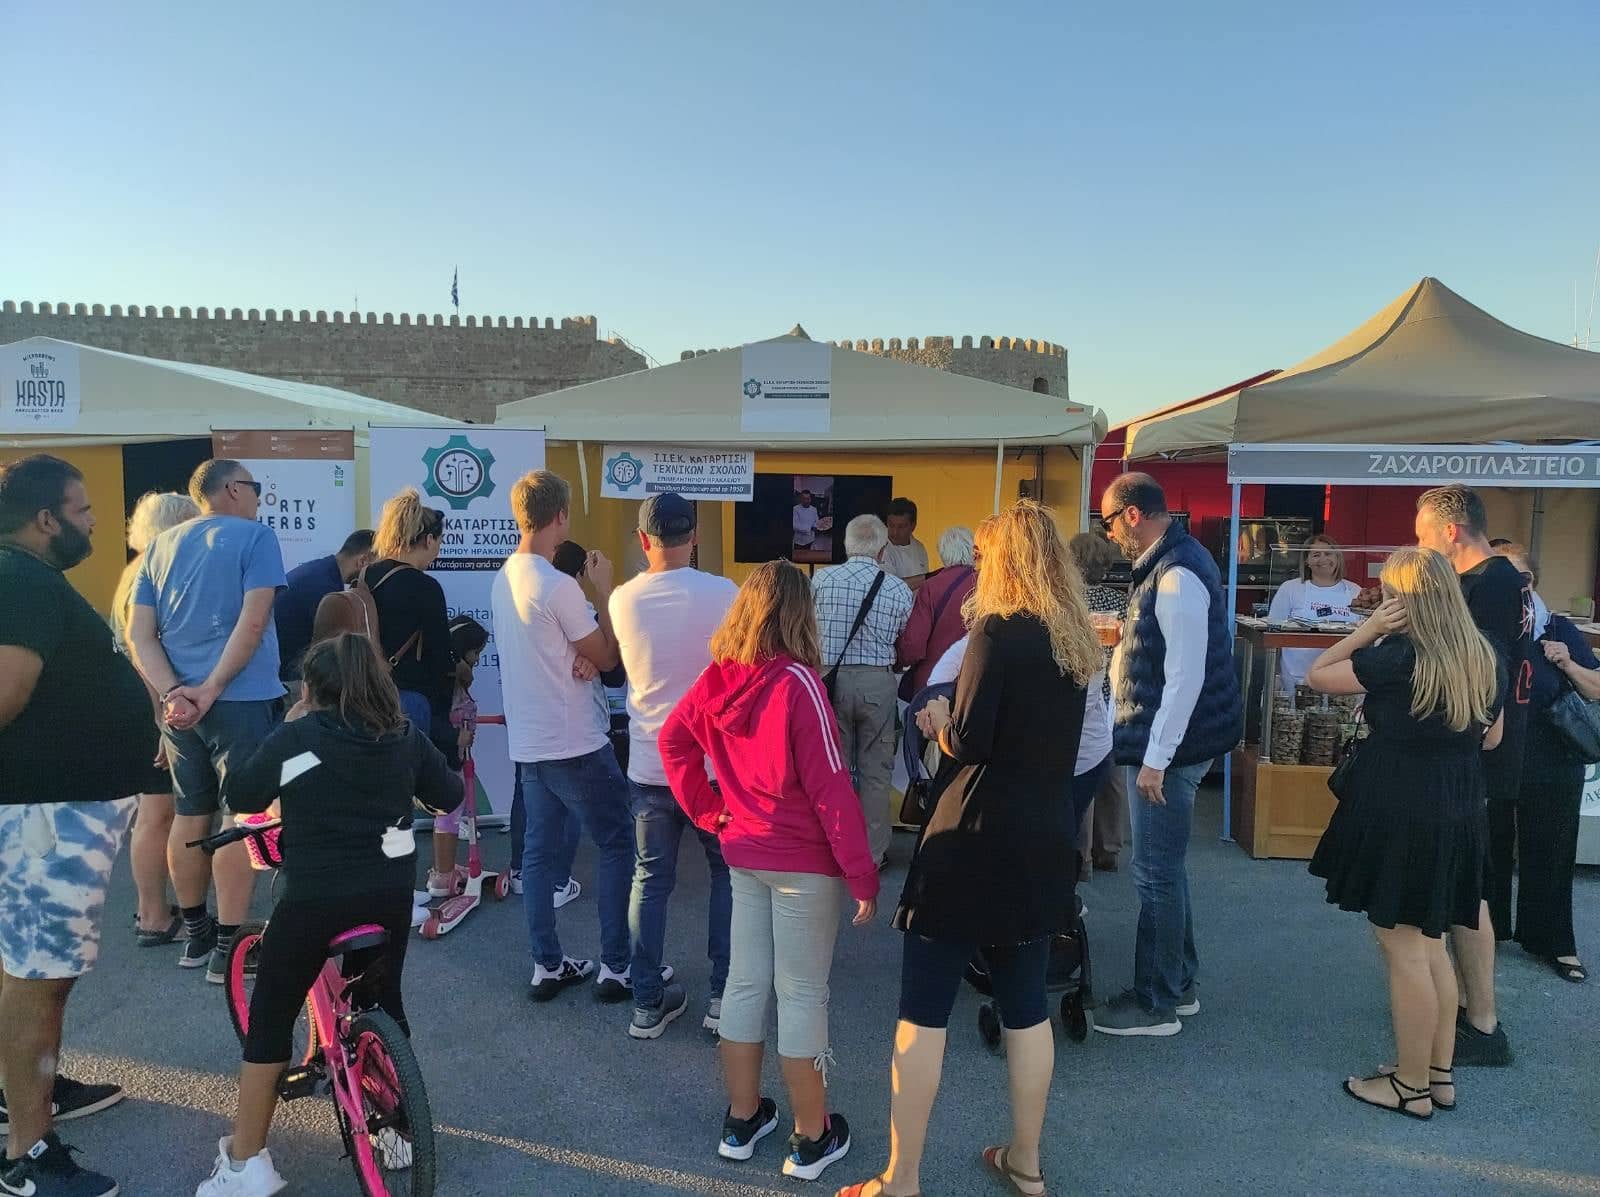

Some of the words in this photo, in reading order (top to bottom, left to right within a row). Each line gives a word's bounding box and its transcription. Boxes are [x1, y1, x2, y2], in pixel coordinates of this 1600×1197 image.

[689, 454, 747, 464] ΚΑΤΑΡΤΙΣΗ
[1368, 454, 1585, 476] ΖΑΧΑΡΟΠΛΑΣΤΕΙΟ
[653, 464, 704, 475] ΤΕΧΝΙΚΩΝ
[709, 465, 747, 476] ΣΧΟΛΩΝ
[257, 493, 316, 513] ORTY
[436, 560, 475, 570] Κατάρτιση
[476, 560, 491, 568] από
